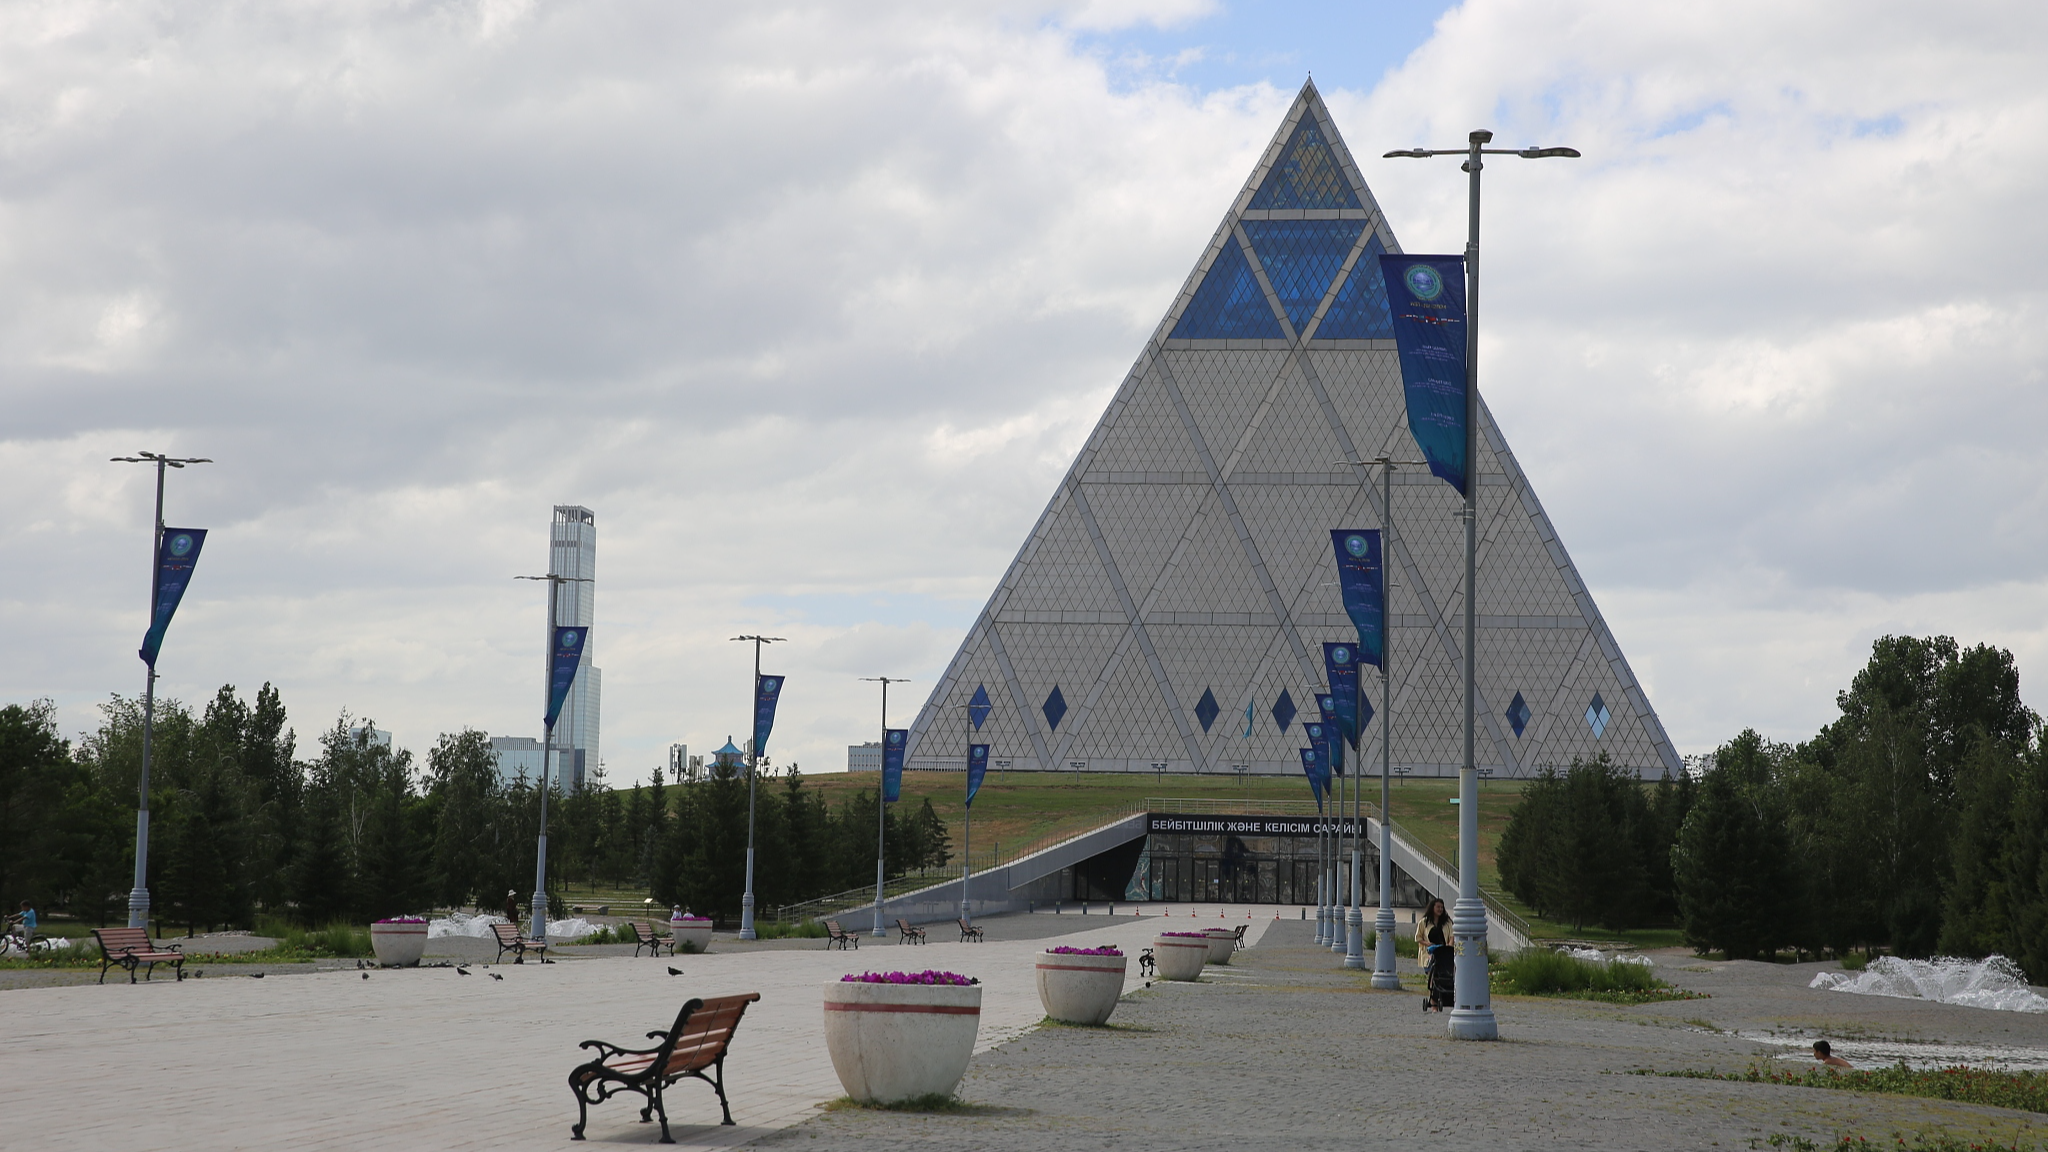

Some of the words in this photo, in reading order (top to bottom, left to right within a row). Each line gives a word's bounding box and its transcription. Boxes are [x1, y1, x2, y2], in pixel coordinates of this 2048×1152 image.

[1152, 818, 1224, 831] БЕЙБІТШІЛІК
[1227, 821, 1260, 832] ЖӘНЕ
[1265, 822, 1310, 833] КЕЛІСІМ
